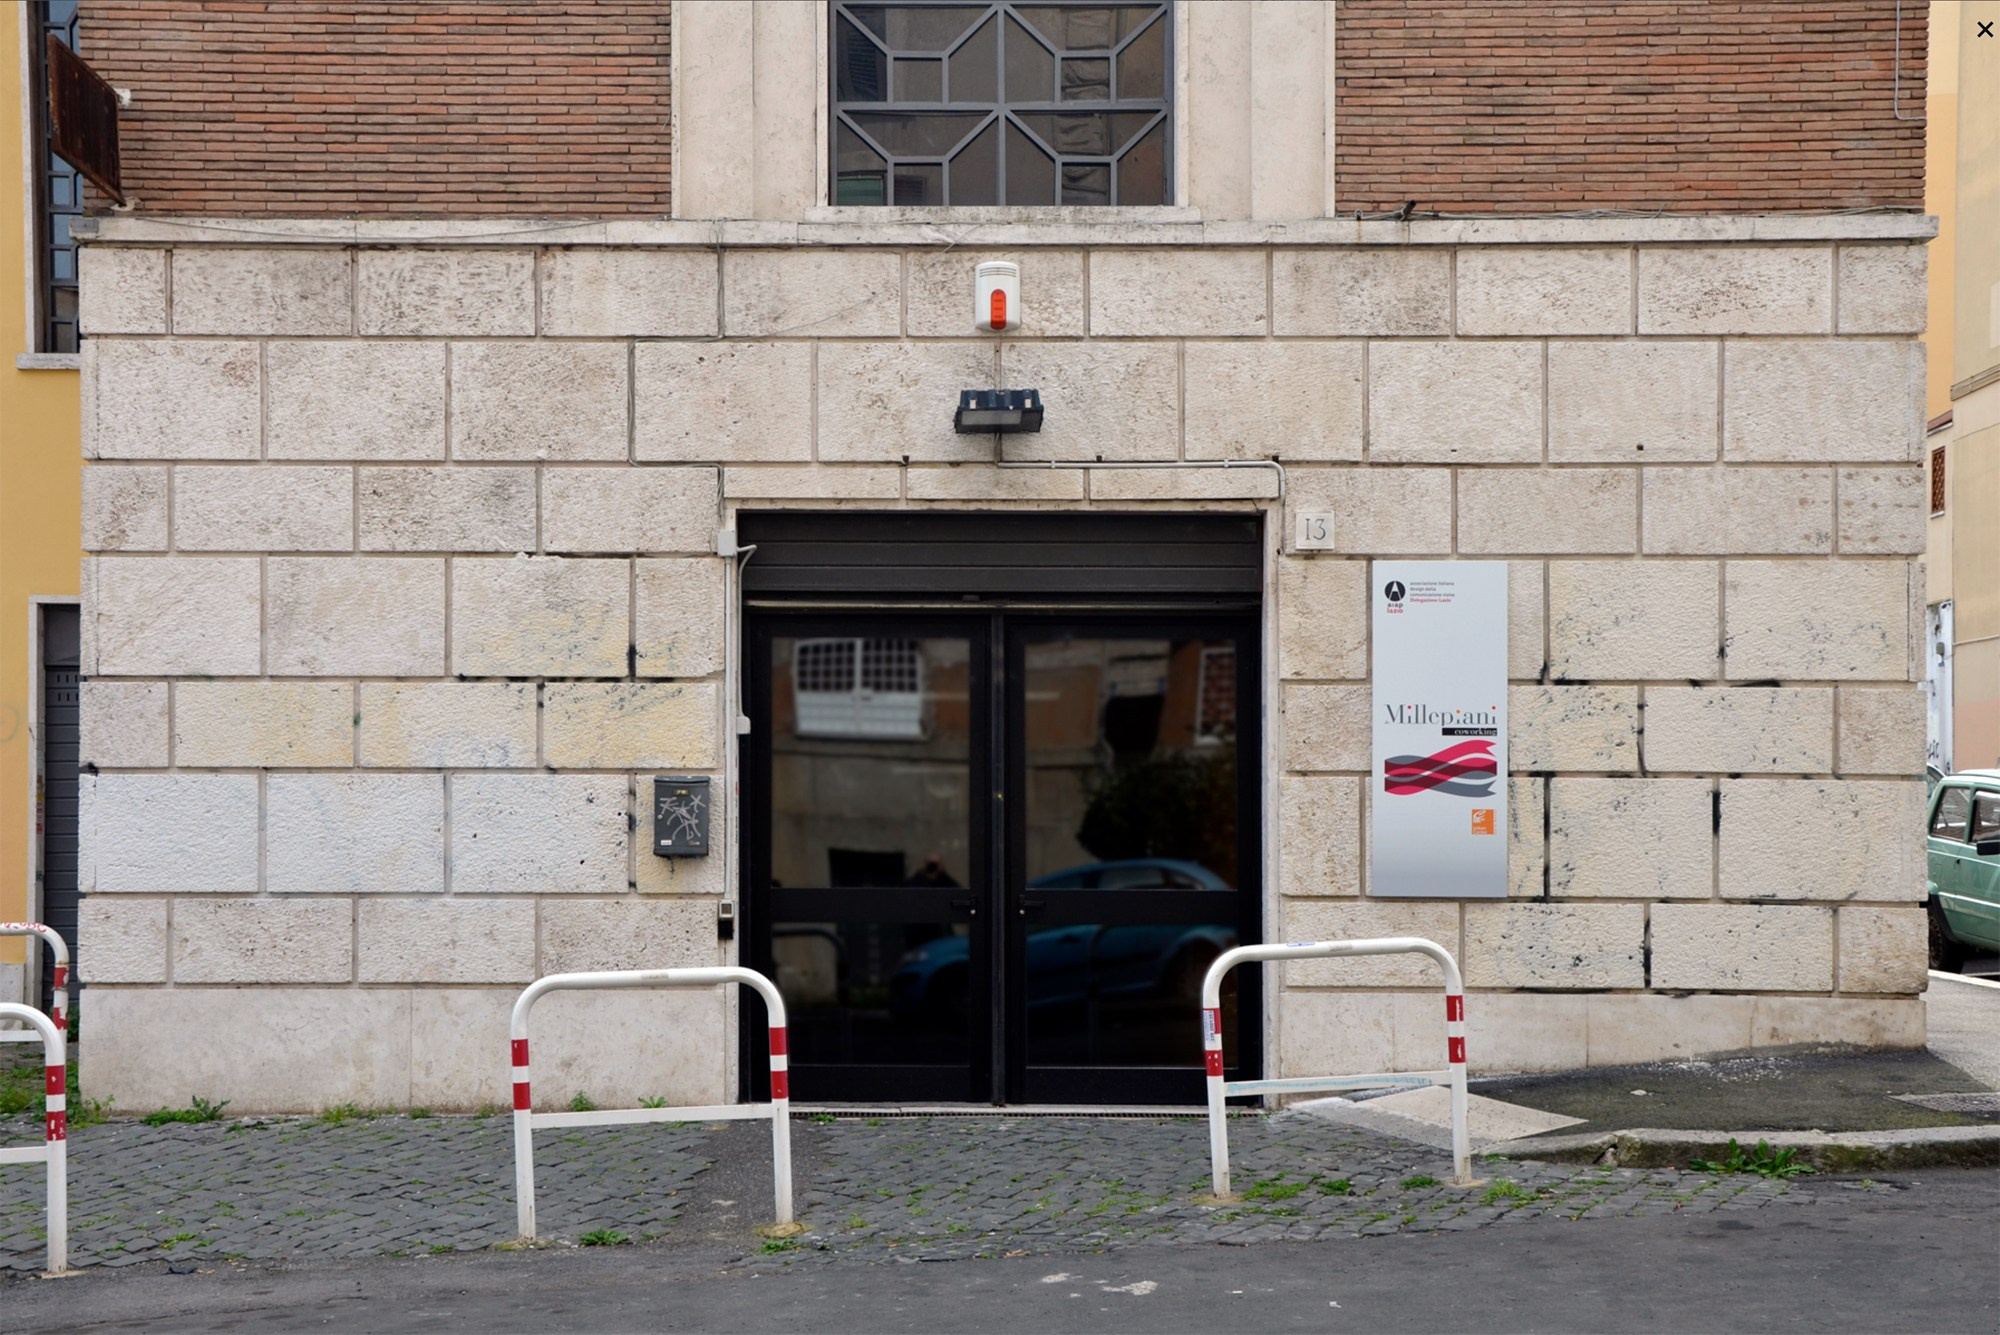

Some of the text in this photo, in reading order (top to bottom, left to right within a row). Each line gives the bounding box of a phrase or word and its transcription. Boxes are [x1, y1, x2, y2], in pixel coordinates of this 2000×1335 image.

[1305, 518, 1326, 540] 13
[1385, 704, 1497, 726] Millepiani
[1454, 728, 1497, 736] coworking
